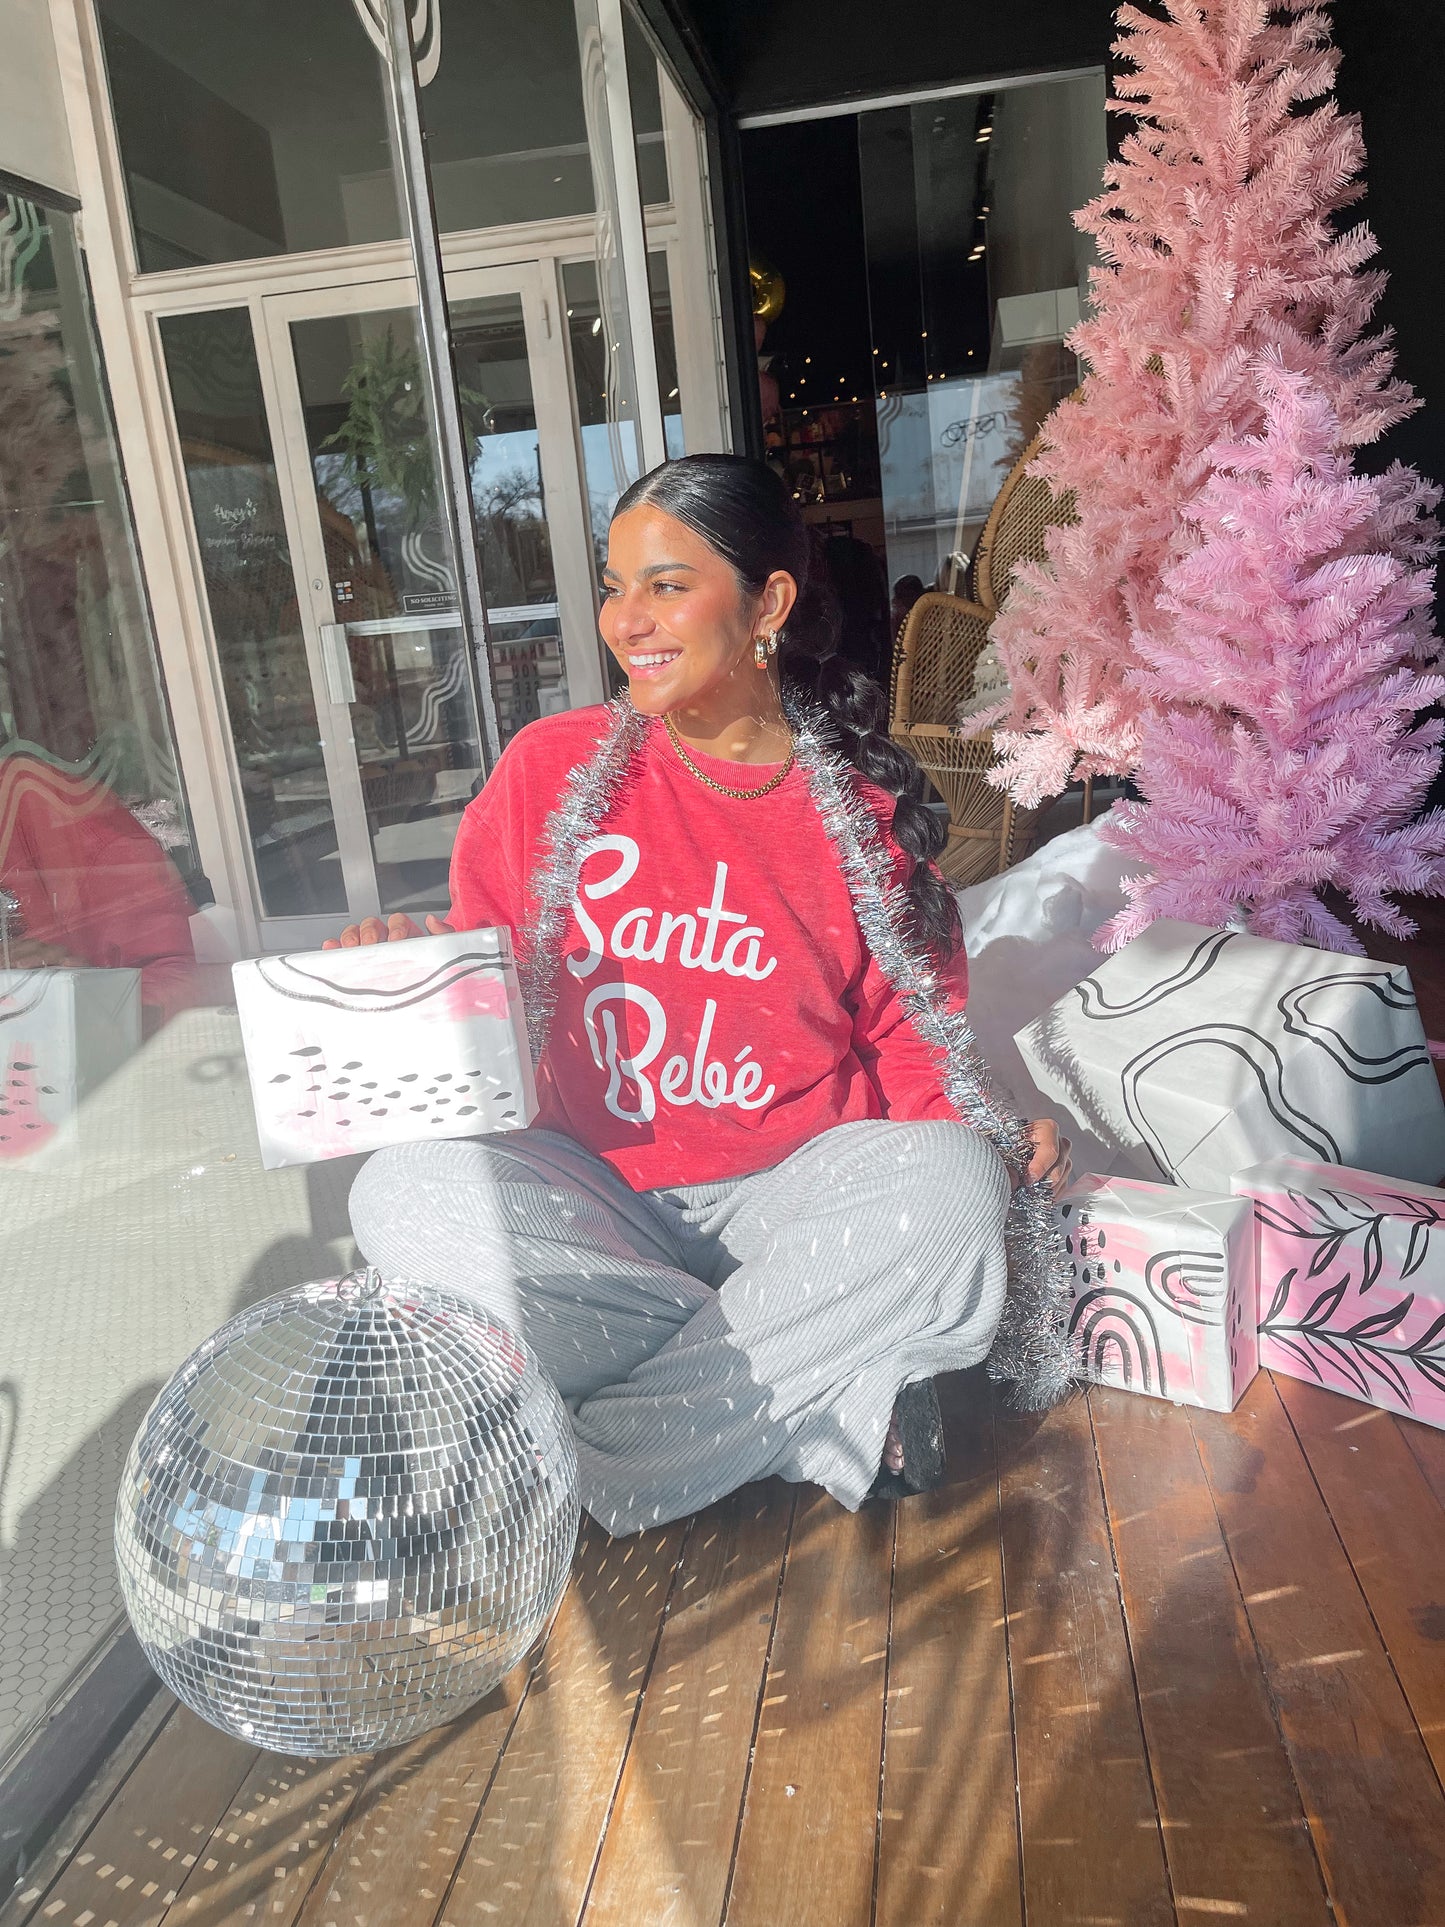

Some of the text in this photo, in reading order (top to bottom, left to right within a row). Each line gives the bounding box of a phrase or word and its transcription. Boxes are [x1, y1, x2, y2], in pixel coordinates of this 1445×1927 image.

[420, 595, 457, 603] SOLICITING
[566, 834, 777, 981] Santa
[583, 982, 775, 1122] Bebé
